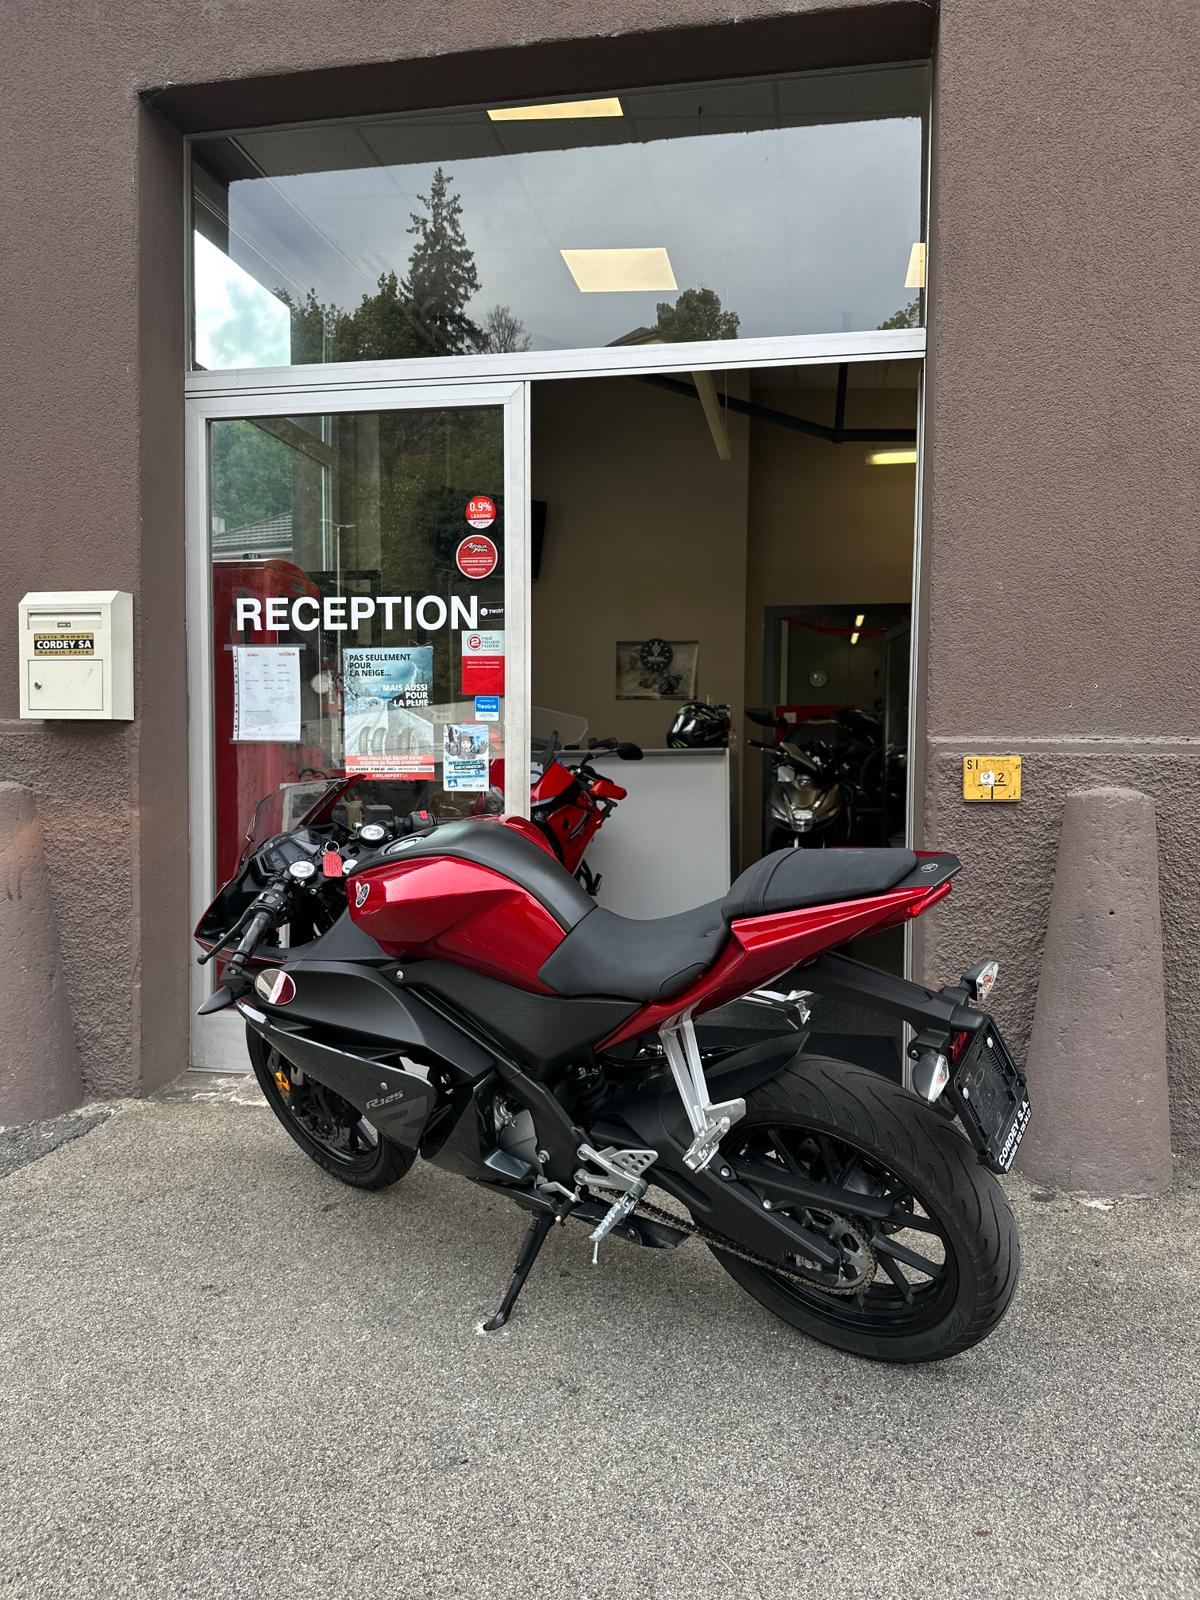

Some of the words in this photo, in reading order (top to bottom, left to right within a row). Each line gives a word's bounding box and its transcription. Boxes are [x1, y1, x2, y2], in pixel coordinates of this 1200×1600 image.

[469, 501, 492, 513] 0.9%
[236, 595, 479, 632] RECEPTION
[37, 640, 76, 649] CORDEY
[78, 640, 92, 649] SA
[349, 654, 364, 662] PAS
[365, 653, 412, 661] SEULEMENT
[349, 669, 360, 677] LA
[361, 669, 392, 677] NEIGE...
[404, 683, 428, 691] AUSSI
[405, 691, 428, 699] POUR
[394, 699, 405, 707] LA
[366, 1089, 404, 1110] R125
[998, 1118, 1019, 1167] CORDEY
[1017, 1100, 1030, 1122] S.A.
